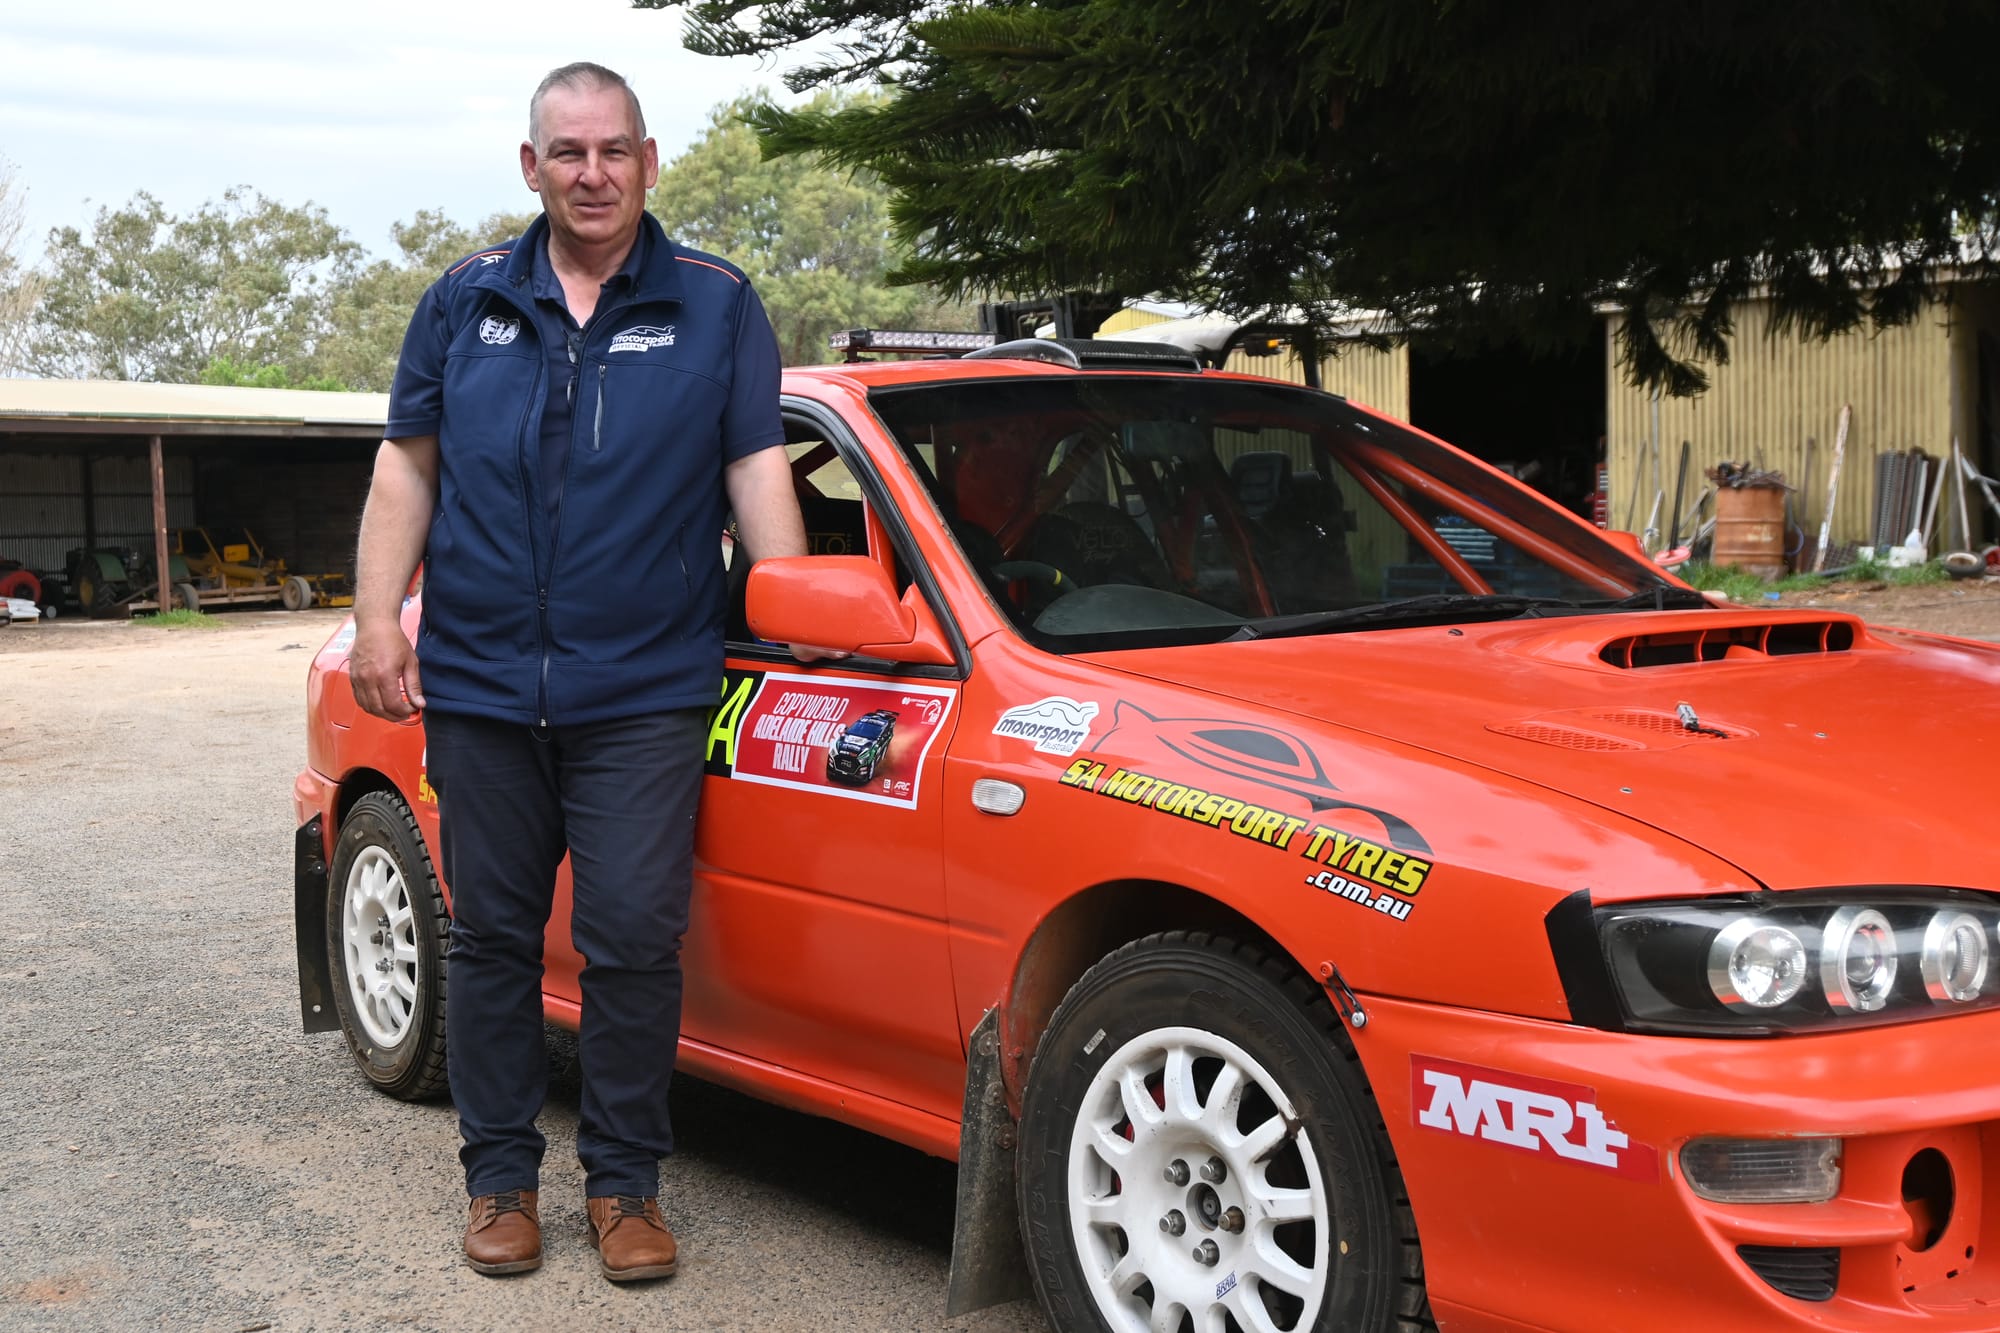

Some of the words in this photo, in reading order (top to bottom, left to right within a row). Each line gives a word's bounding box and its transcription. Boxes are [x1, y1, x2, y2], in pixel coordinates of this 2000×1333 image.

[611, 334, 675, 347] motorsport
[772, 691, 850, 722] COPYWORLD
[752, 713, 811, 744] ADELAIDE
[806, 720, 847, 748] HILLS
[997, 718, 1084, 747] motorsport
[772, 742, 811, 774] RALLY
[1043, 742, 1074, 753] australia
[1060, 758, 1097, 790] SA
[1098, 767, 1306, 850] MOTORSPORT
[1303, 823, 1433, 896] TYRES
[1305, 871, 1413, 921] .com.au
